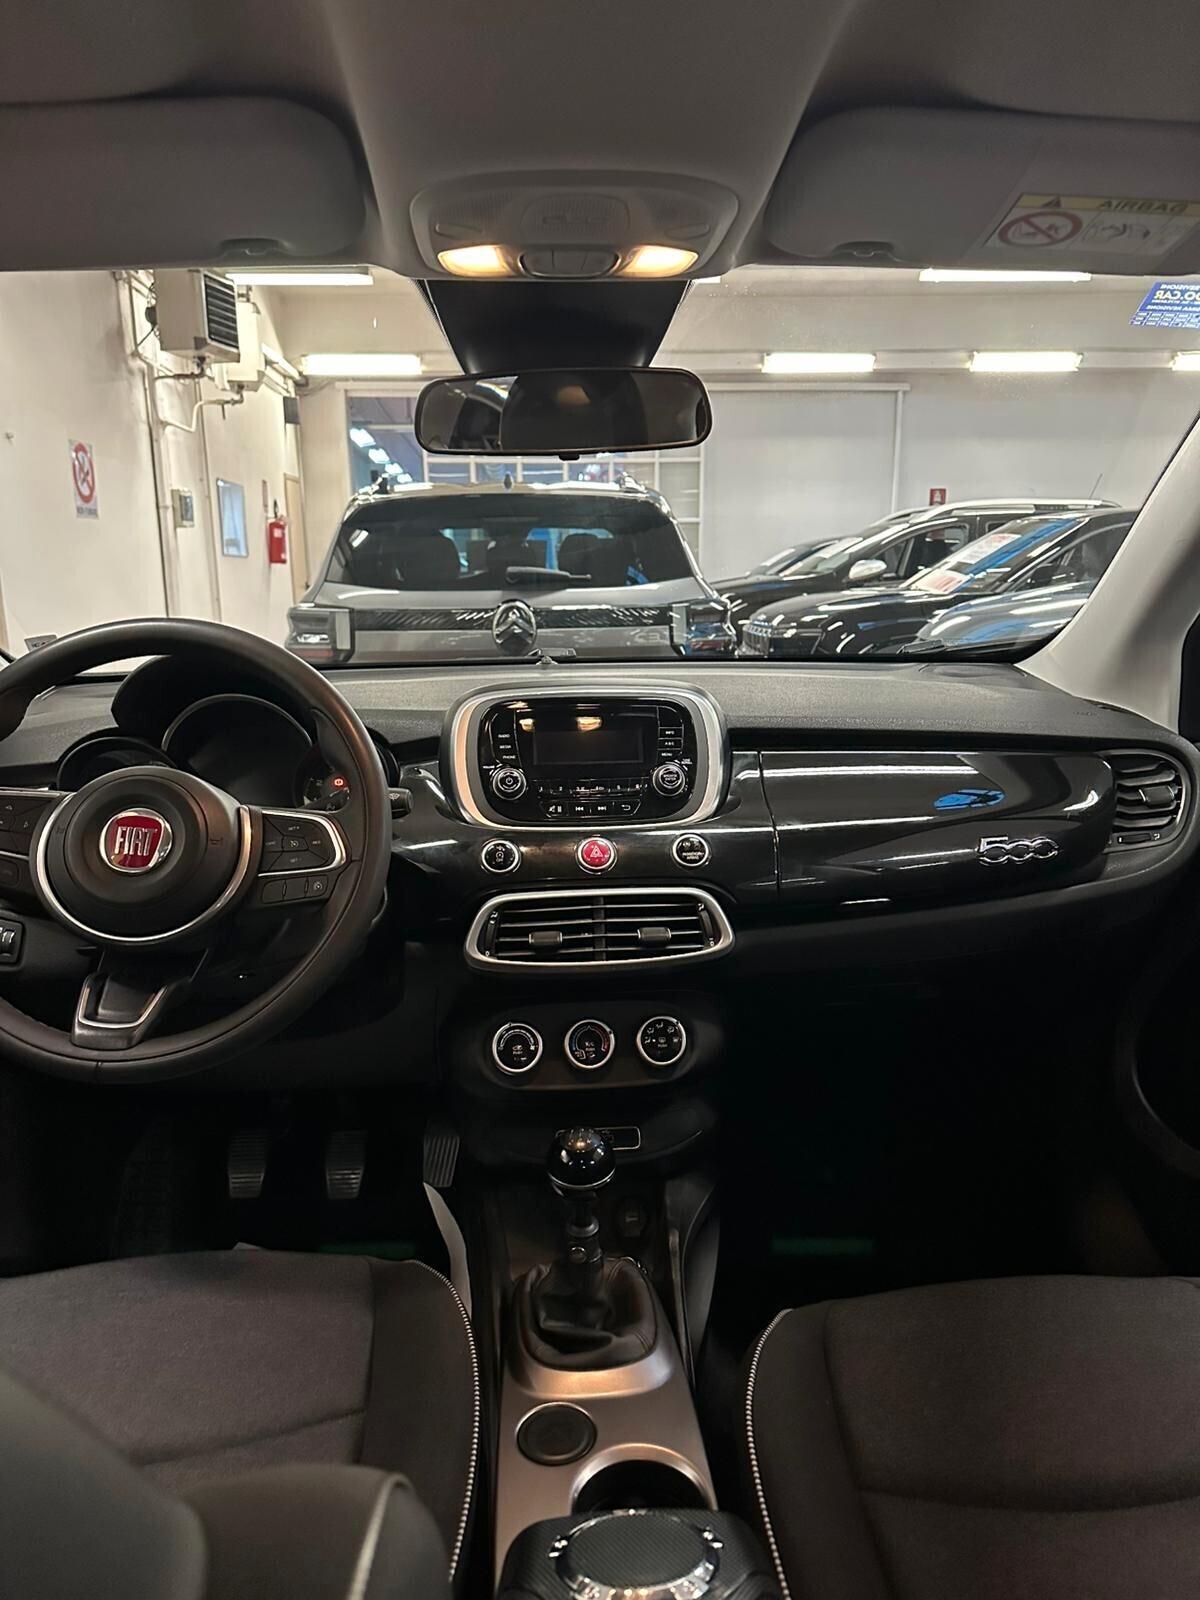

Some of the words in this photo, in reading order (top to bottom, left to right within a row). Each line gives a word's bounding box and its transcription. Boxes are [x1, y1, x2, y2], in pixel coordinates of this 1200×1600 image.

[1097, 199, 1188, 214] AIRBAG
[114, 826, 158, 857] FIAT
[978, 836, 1060, 866] 500
